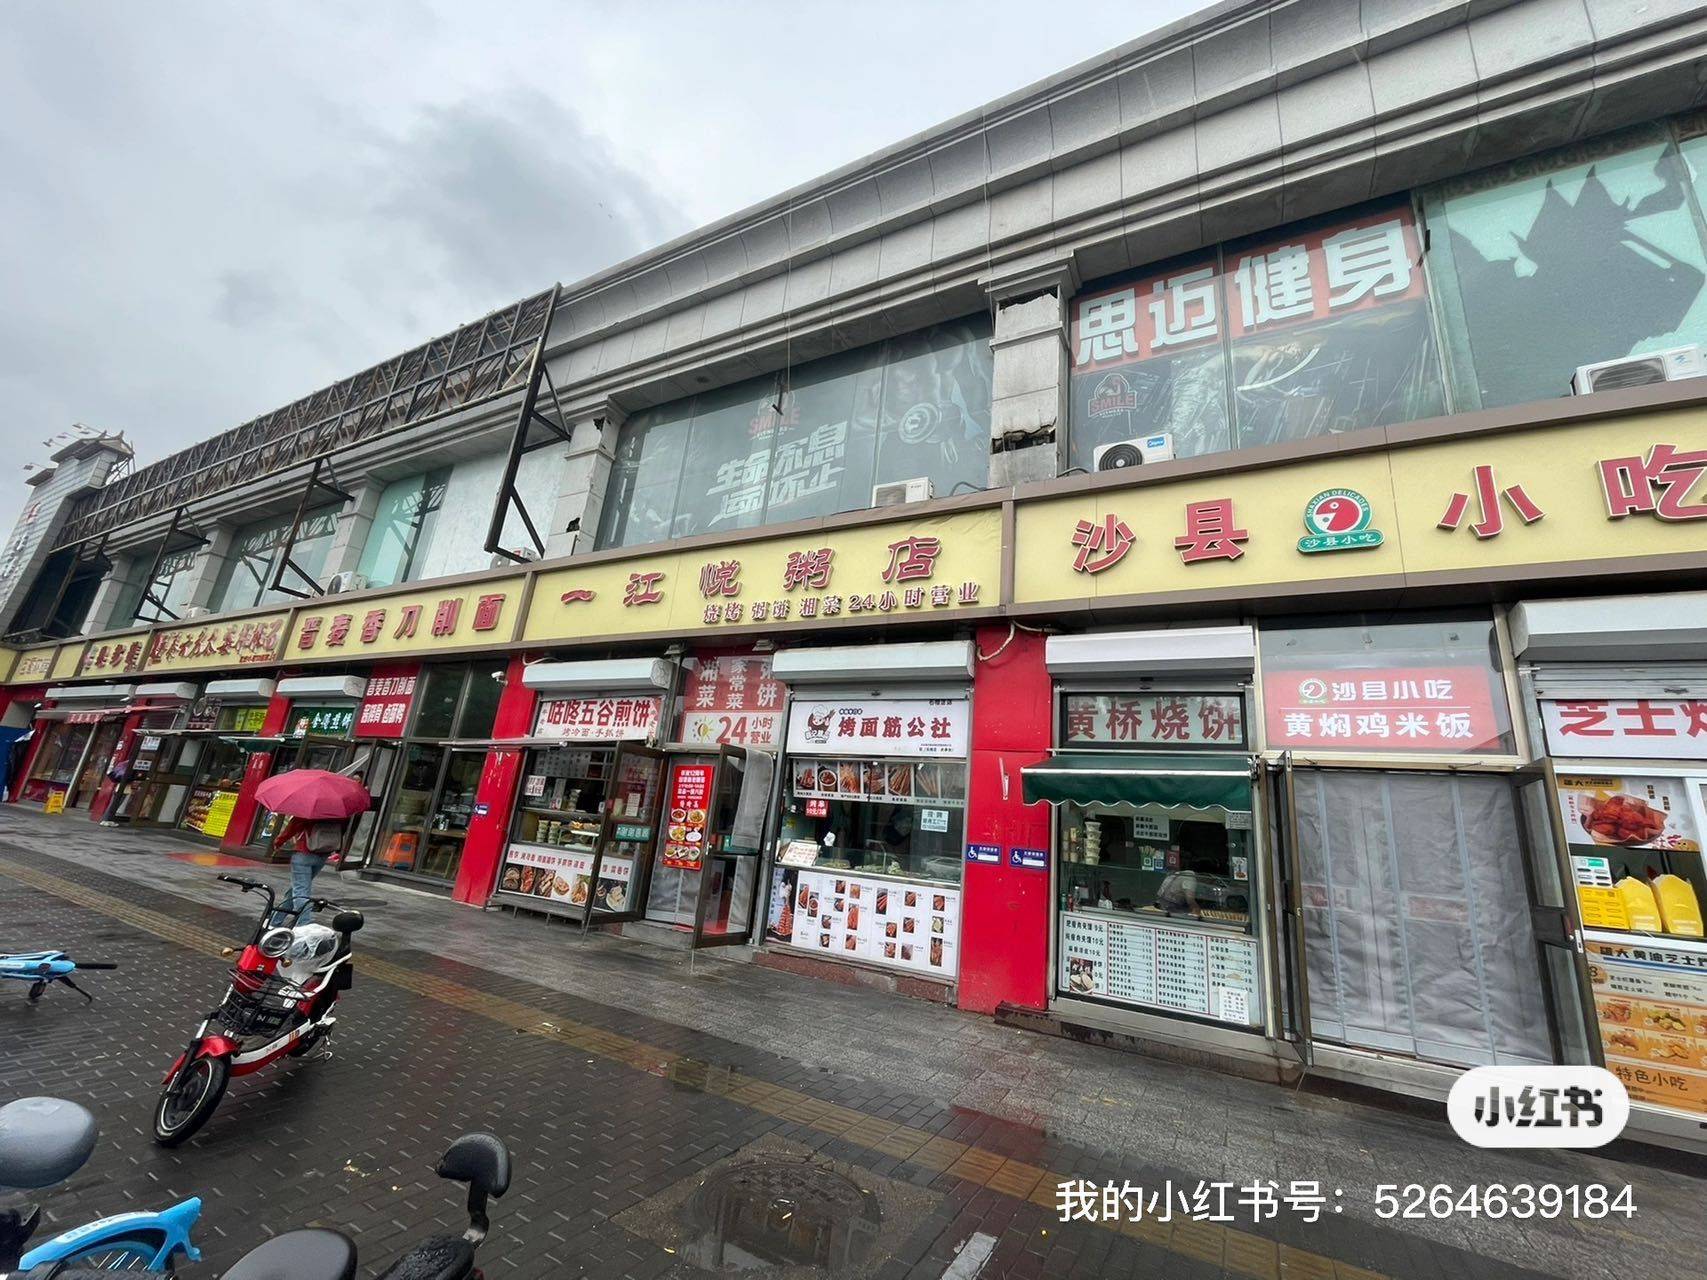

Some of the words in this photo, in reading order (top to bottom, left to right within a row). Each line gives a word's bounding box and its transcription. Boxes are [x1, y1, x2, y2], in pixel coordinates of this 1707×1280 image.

[1077, 221, 1413, 366] 思迈健身
[706, 421, 847, 496] 生命不息
[708, 466, 846, 528] 运动不止
[1071, 498, 1249, 575] 沙县
[1437, 443, 1707, 540] 小吃
[1304, 533, 1376, 548] 沙县小吃
[561, 536, 942, 607] 一江悦粥店
[298, 593, 506, 650] 晋麦香刀削面
[703, 600, 743, 624] 烧烤
[799, 595, 840, 616] 湘菜
[849, 581, 980, 612] 24小时营业
[696, 660, 720, 708] 湘菜
[726, 659, 747, 710] 家常菜
[1331, 679, 1453, 702] 沙县小吃
[547, 699, 651, 728] 咕咚五谷煎饼
[716, 716, 748, 744] 24
[751, 717, 773, 730] 小时
[838, 716, 951, 738] 烤面筋公社
[1068, 699, 1240, 741] 黄桥烧饼
[1284, 711, 1474, 738] 黄焖鸡米饭
[750, 731, 772, 744] 营业
[1615, 1065, 1689, 1092] 特色小吃
